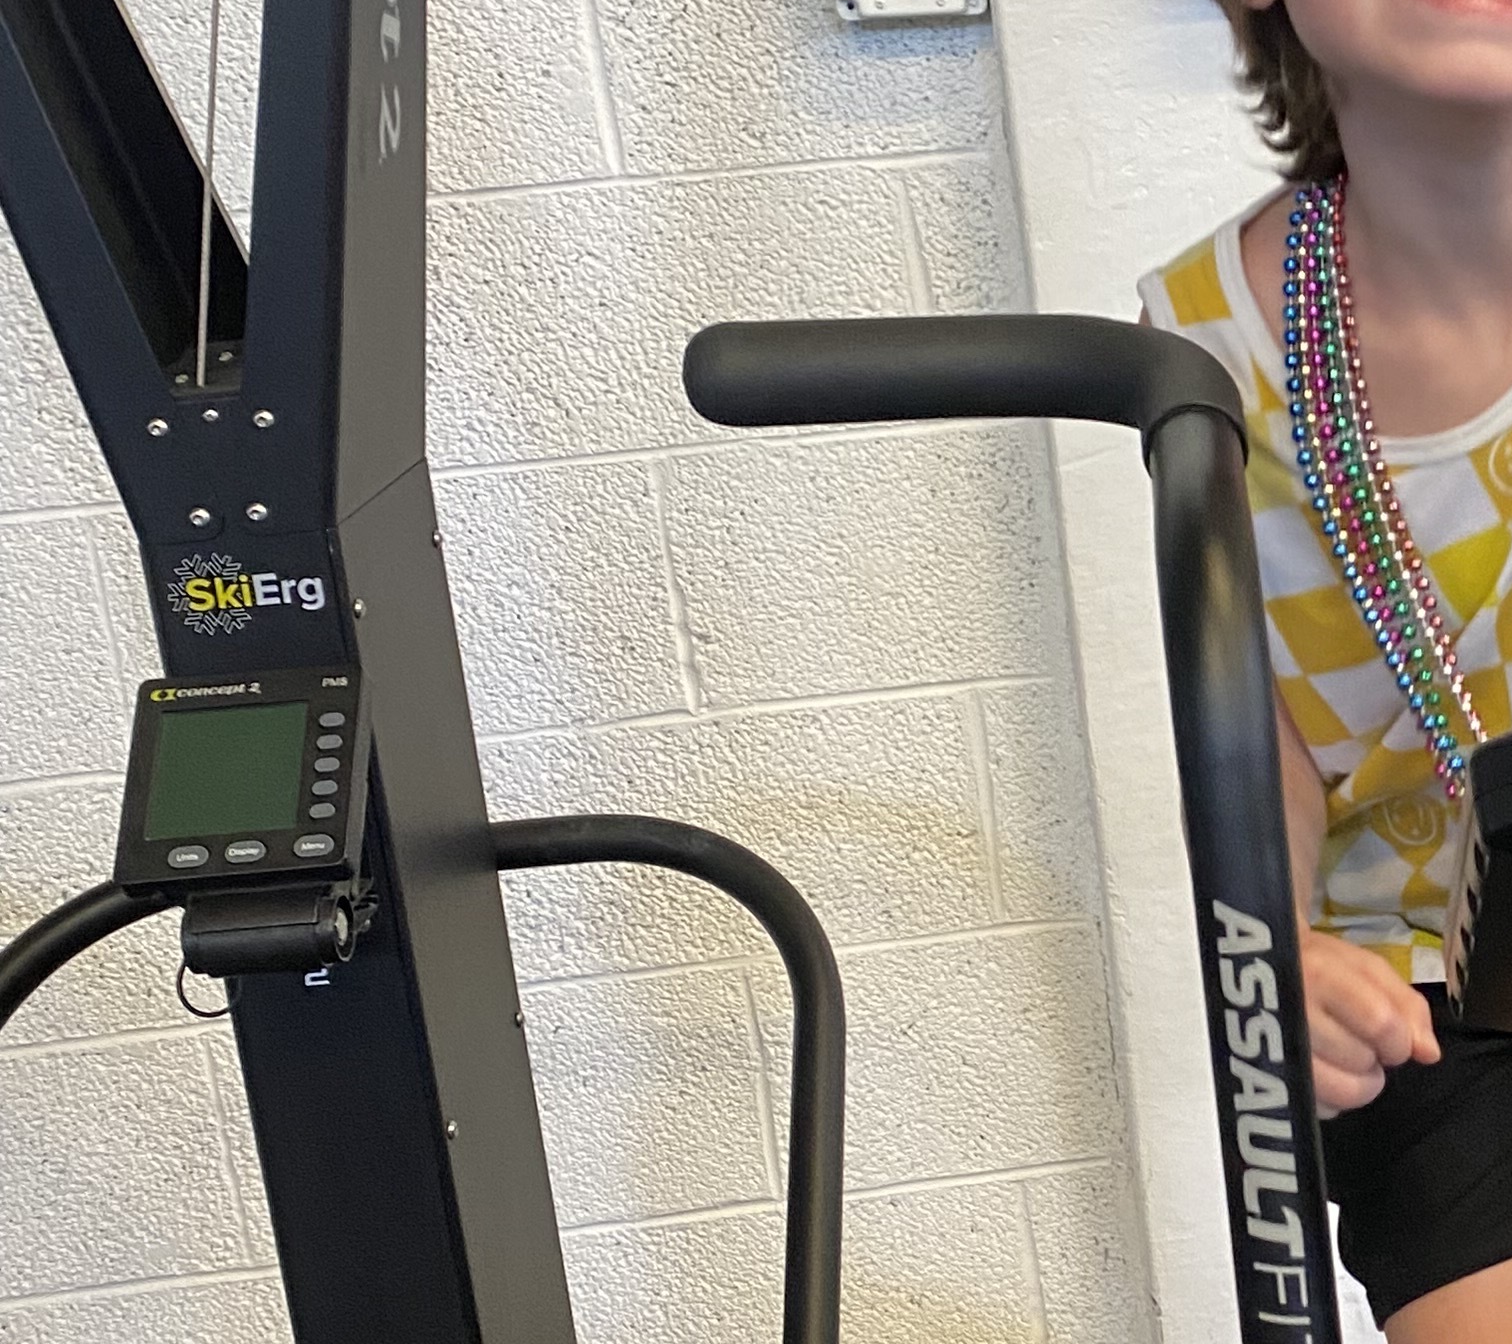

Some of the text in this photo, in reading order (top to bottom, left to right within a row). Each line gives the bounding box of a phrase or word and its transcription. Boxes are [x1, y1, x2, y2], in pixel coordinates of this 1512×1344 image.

[379, 81, 400, 158] 2
[185, 572, 325, 611] SkiErg
[177, 685, 245, 699] concept
